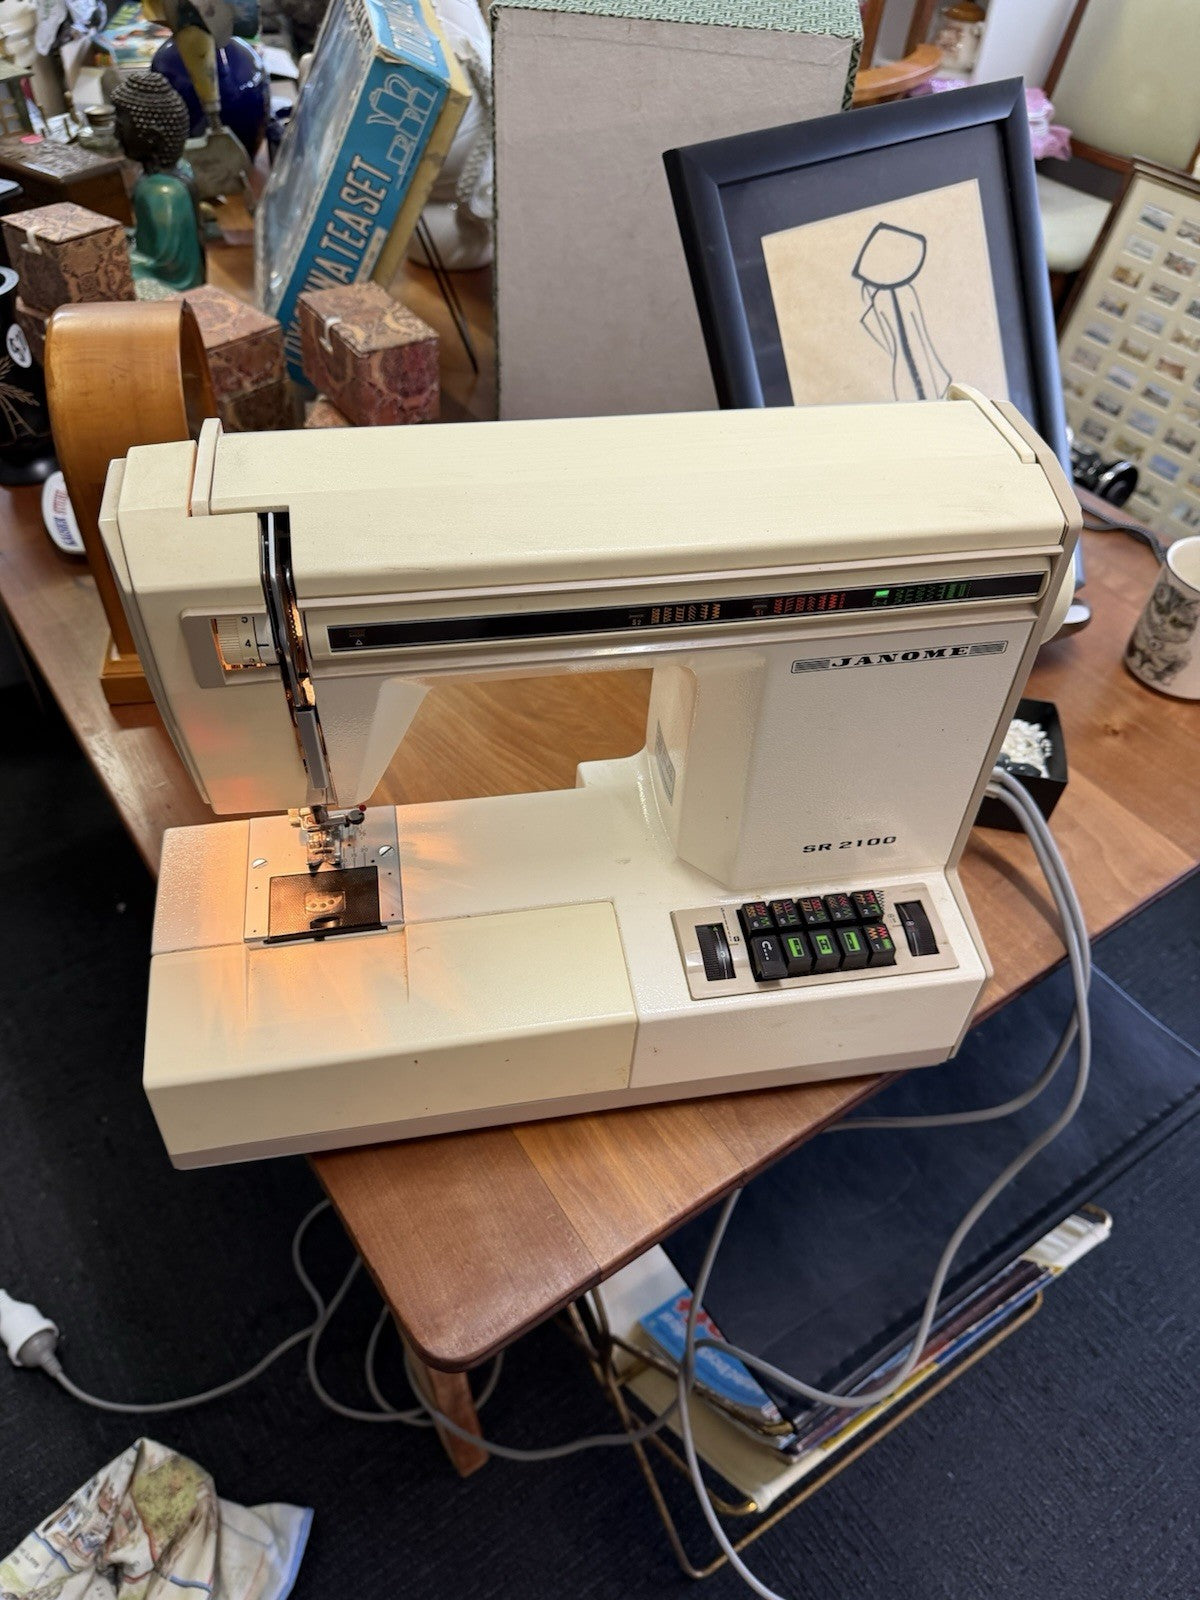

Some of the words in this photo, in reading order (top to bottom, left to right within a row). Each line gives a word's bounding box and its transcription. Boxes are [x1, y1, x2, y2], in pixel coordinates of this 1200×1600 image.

[340, 153, 393, 216] SET
[319, 207, 376, 262] TEA
[245, 639, 252, 648] 4
[832, 646, 969, 667] JANOME
[802, 843, 832, 853] SR
[839, 836, 897, 849] 2100
